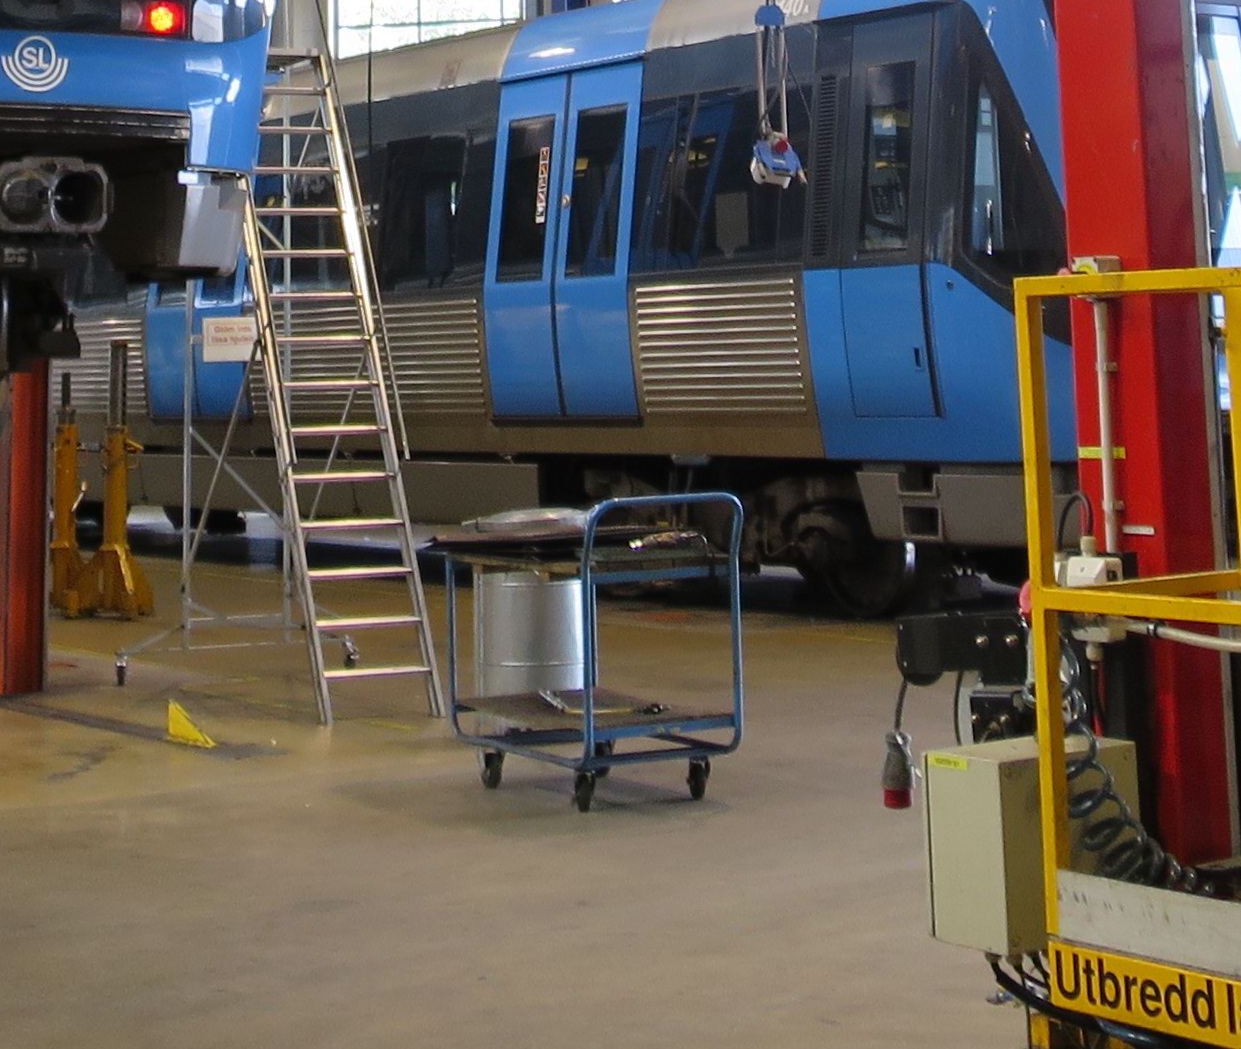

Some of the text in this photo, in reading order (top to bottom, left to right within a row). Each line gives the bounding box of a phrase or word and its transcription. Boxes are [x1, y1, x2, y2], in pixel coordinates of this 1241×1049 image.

[21, 47, 50, 70] SL
[1054, 949, 1241, 1035] Utbredd l
